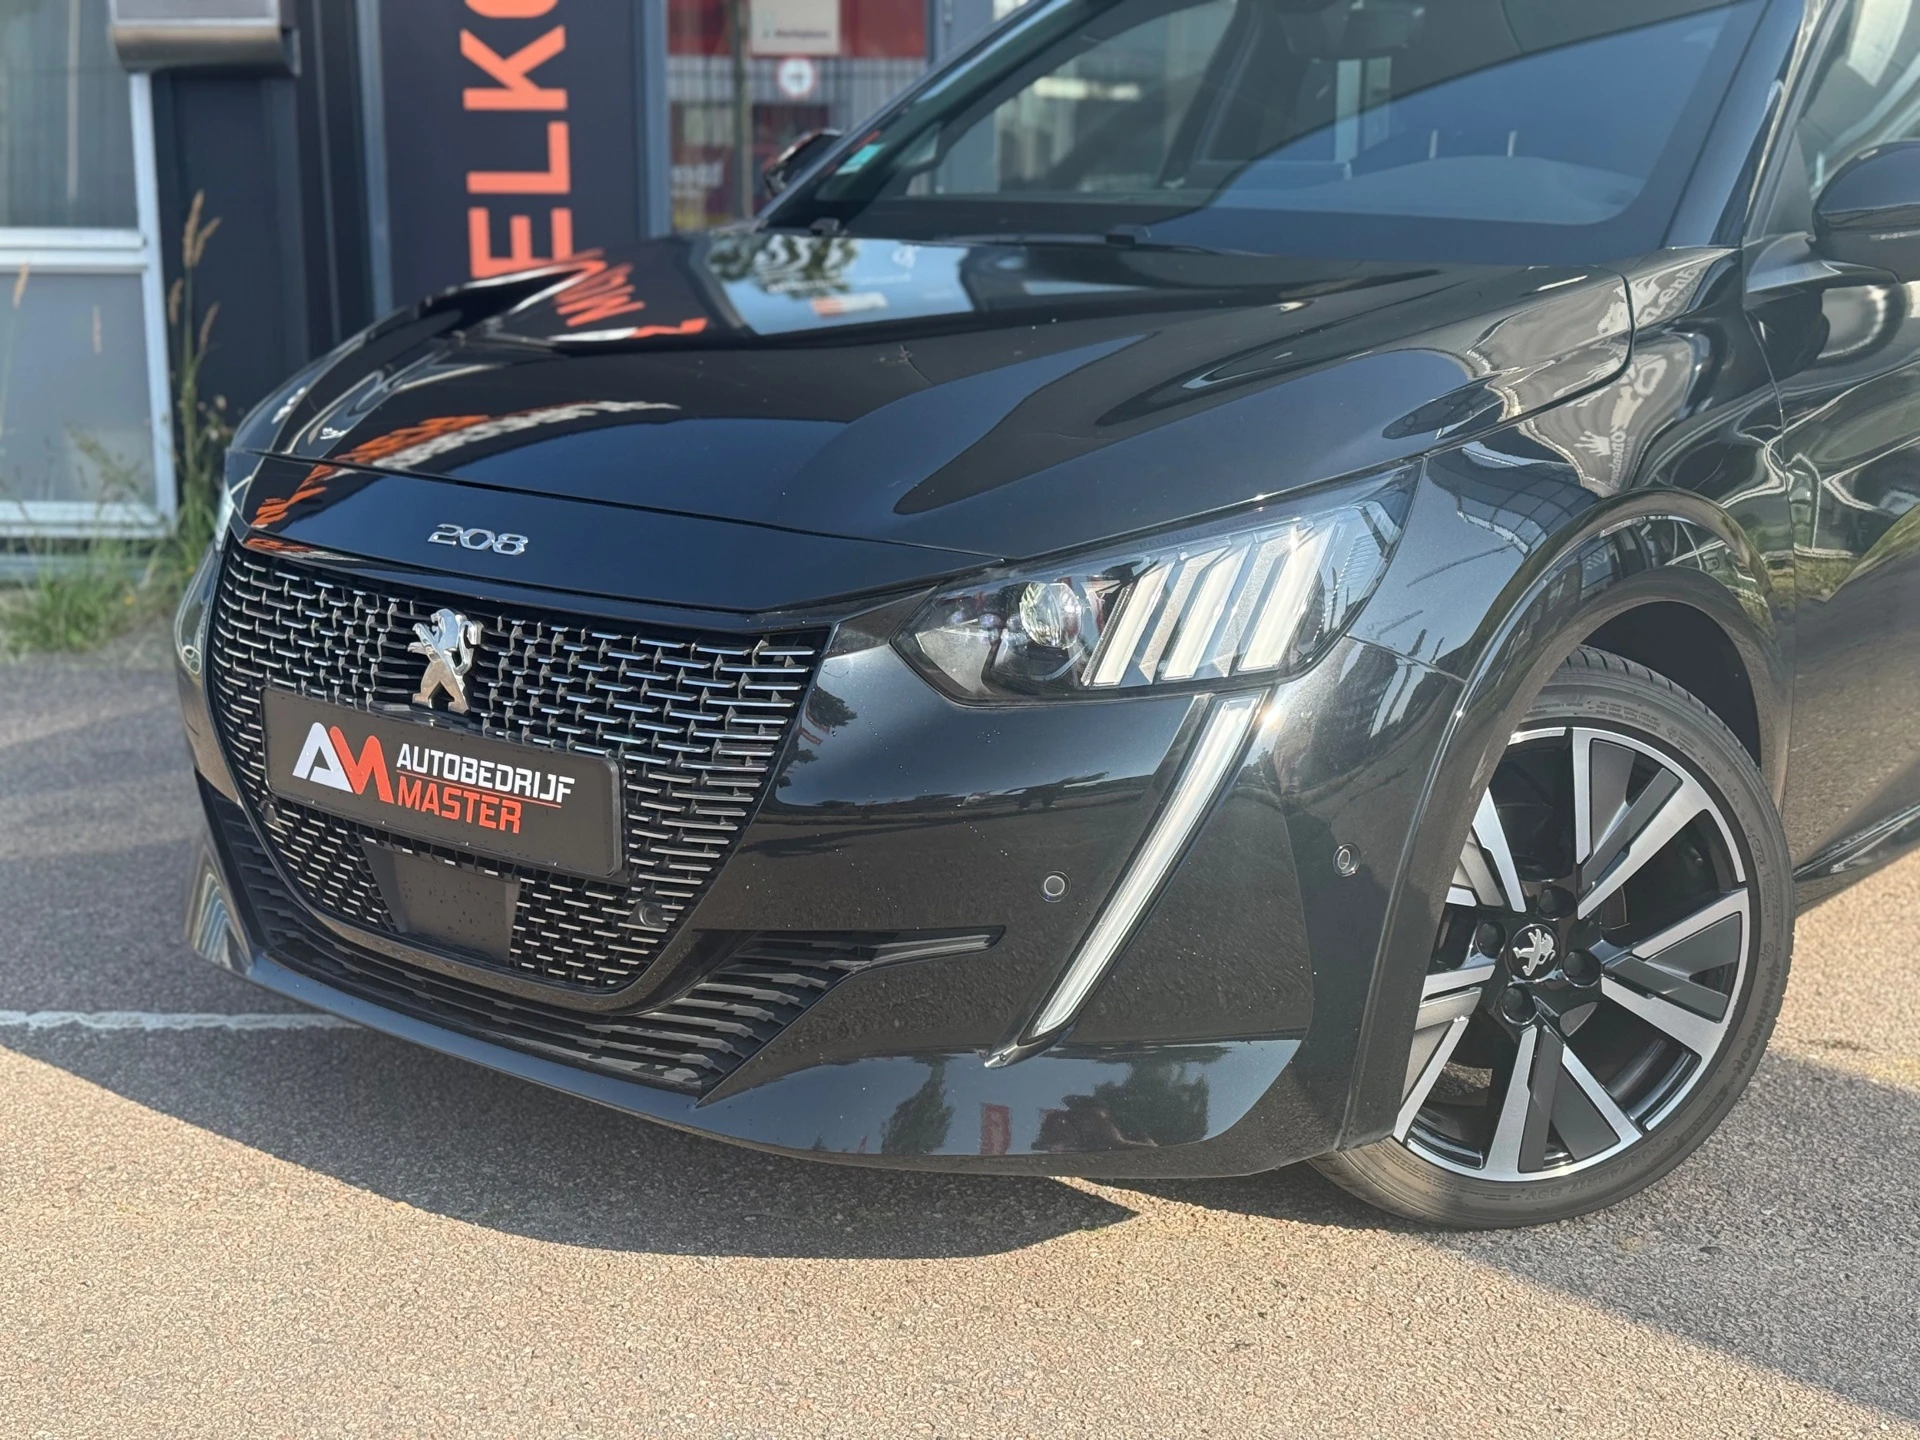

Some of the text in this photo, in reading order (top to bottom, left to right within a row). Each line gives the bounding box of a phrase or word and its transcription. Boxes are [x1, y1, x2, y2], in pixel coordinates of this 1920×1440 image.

[460, 0, 573, 279] ELK
[427, 523, 529, 556] 208
[396, 742, 575, 803] AUTOBEDRIJF
[397, 775, 523, 834] MASTER
